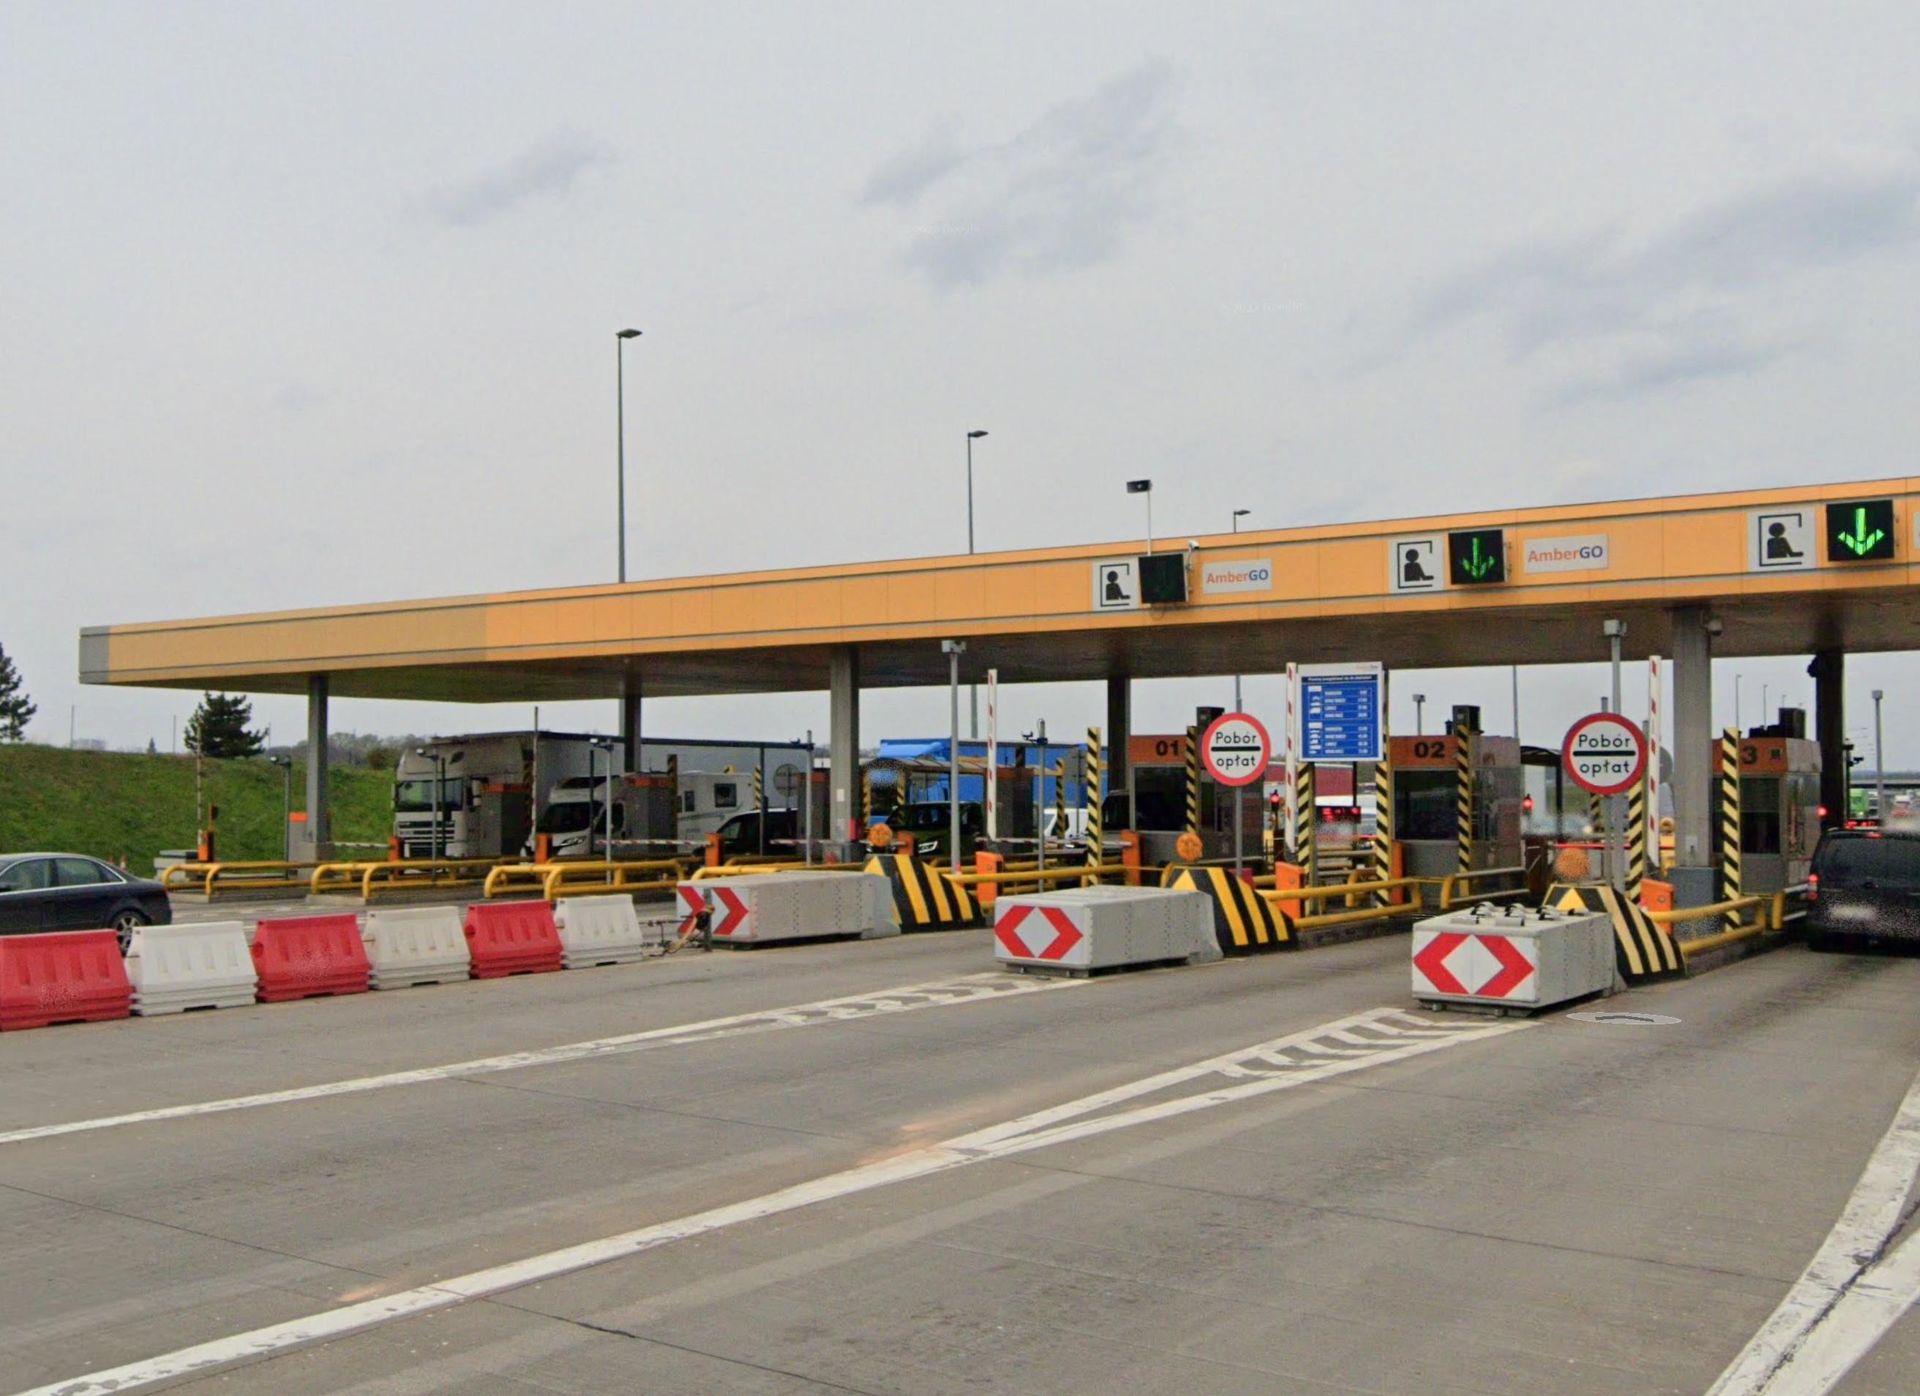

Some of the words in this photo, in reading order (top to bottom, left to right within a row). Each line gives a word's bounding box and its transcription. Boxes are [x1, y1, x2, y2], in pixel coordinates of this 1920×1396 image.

[1528, 545, 1603, 562] AmberGO
[1206, 569, 1269, 584] AmberGO
[1215, 730, 1257, 744] Pobór
[1578, 733, 1631, 748] Pobór
[1156, 740, 1179, 756] 01
[1414, 741, 1445, 759] 02
[1741, 745, 1757, 765] 3
[1216, 754, 1256, 770] opłat
[1579, 759, 1630, 777] opłat
